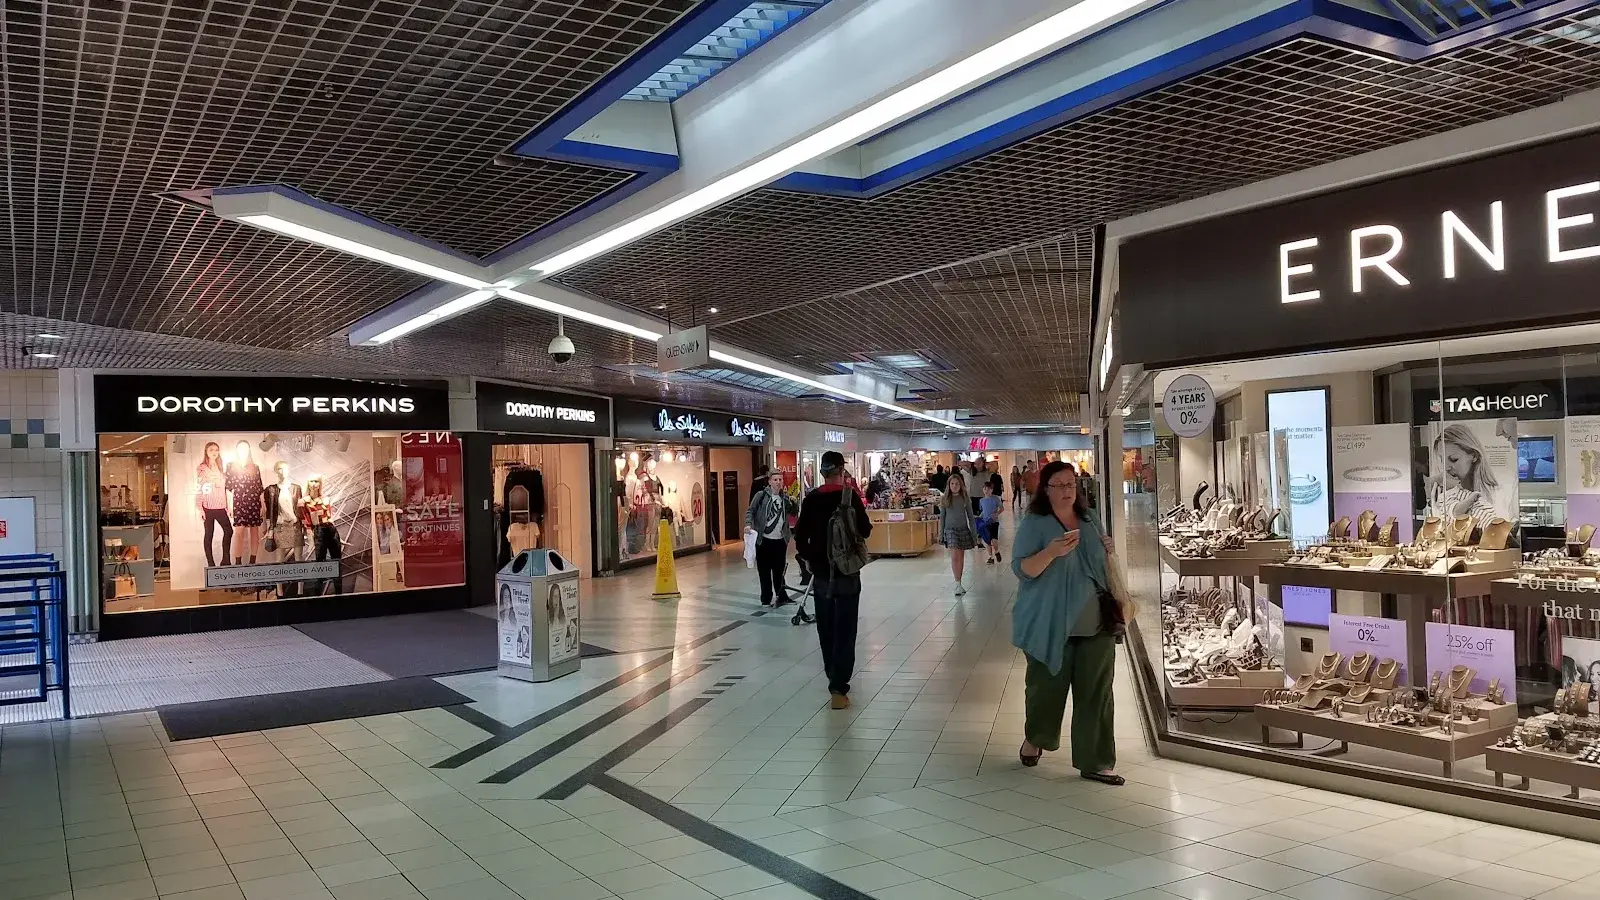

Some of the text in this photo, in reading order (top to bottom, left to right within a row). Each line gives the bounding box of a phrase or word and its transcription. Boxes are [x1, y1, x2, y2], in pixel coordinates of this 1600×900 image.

[1280, 181, 1600, 304] ERNE
[665, 341, 695, 358] QUEENSWAY
[137, 396, 415, 413] DOROTHY PERKINS
[1171, 392, 1206, 405] 4 YEARS
[506, 402, 596, 422] DOROTHY PERKINS
[1180, 411, 1198, 425] 0%
[777, 465, 797, 473] SALE
[406, 502, 460, 520] SALE
[693, 499, 702, 517] 20
[407, 524, 460, 533] CONTINUES
[214, 565, 333, 581] Style Heroes Collection AW16
[1542, 599, 1583, 620] that
[1343, 619, 1362, 627] Interest
[1357, 628, 1375, 642] 0%
[1446, 634, 1495, 652] 25% off
